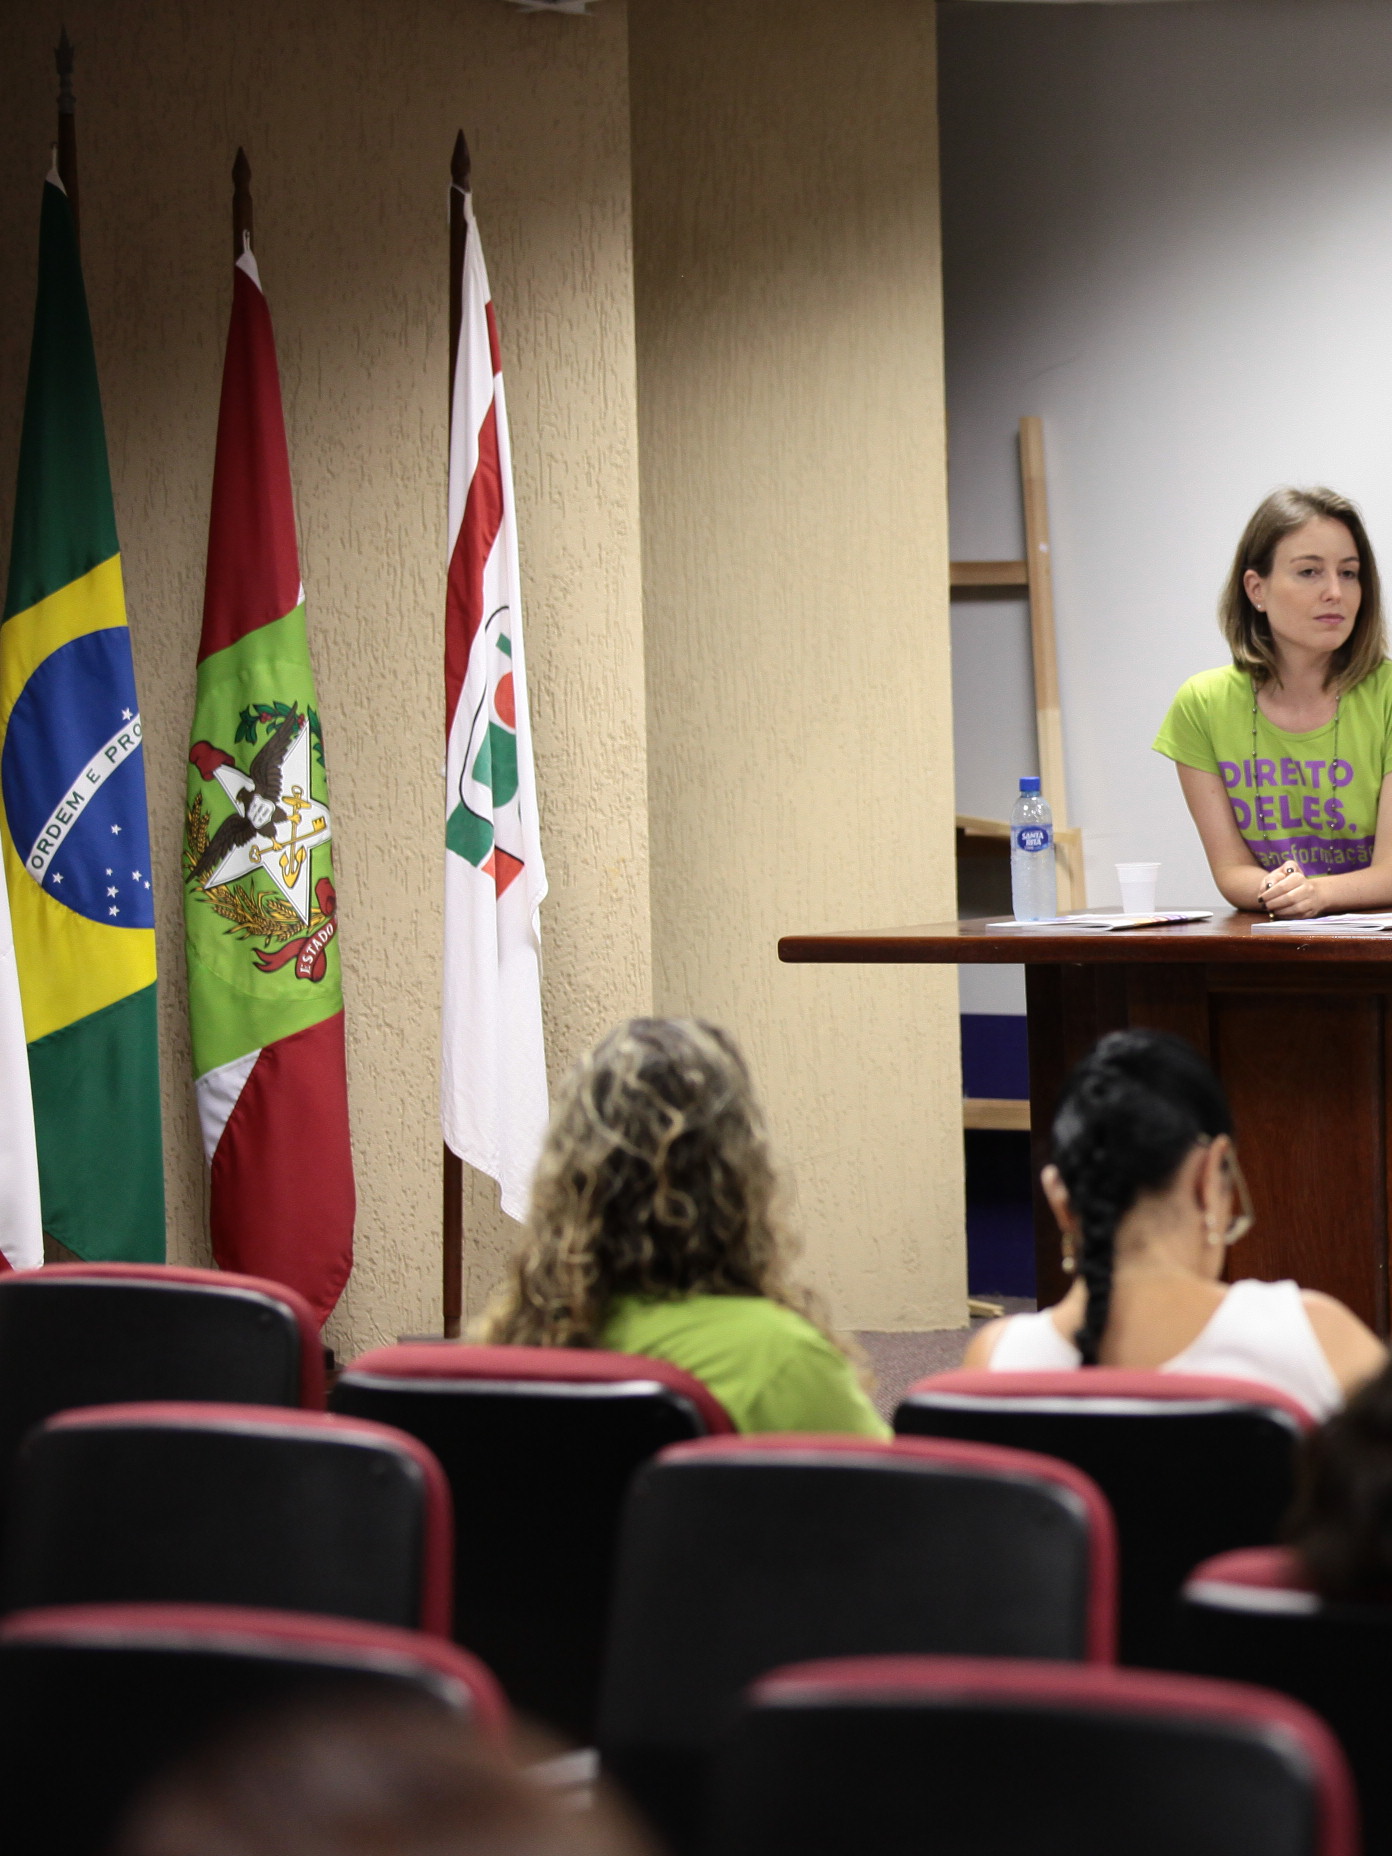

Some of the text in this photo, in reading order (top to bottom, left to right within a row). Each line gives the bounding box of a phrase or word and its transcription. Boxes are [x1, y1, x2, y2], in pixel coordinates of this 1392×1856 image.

[1218, 757, 1355, 789] DIREITO
[31, 790, 85, 870] ORDEM
[86, 768, 102, 784] E
[300, 922, 334, 975] ESTADO
